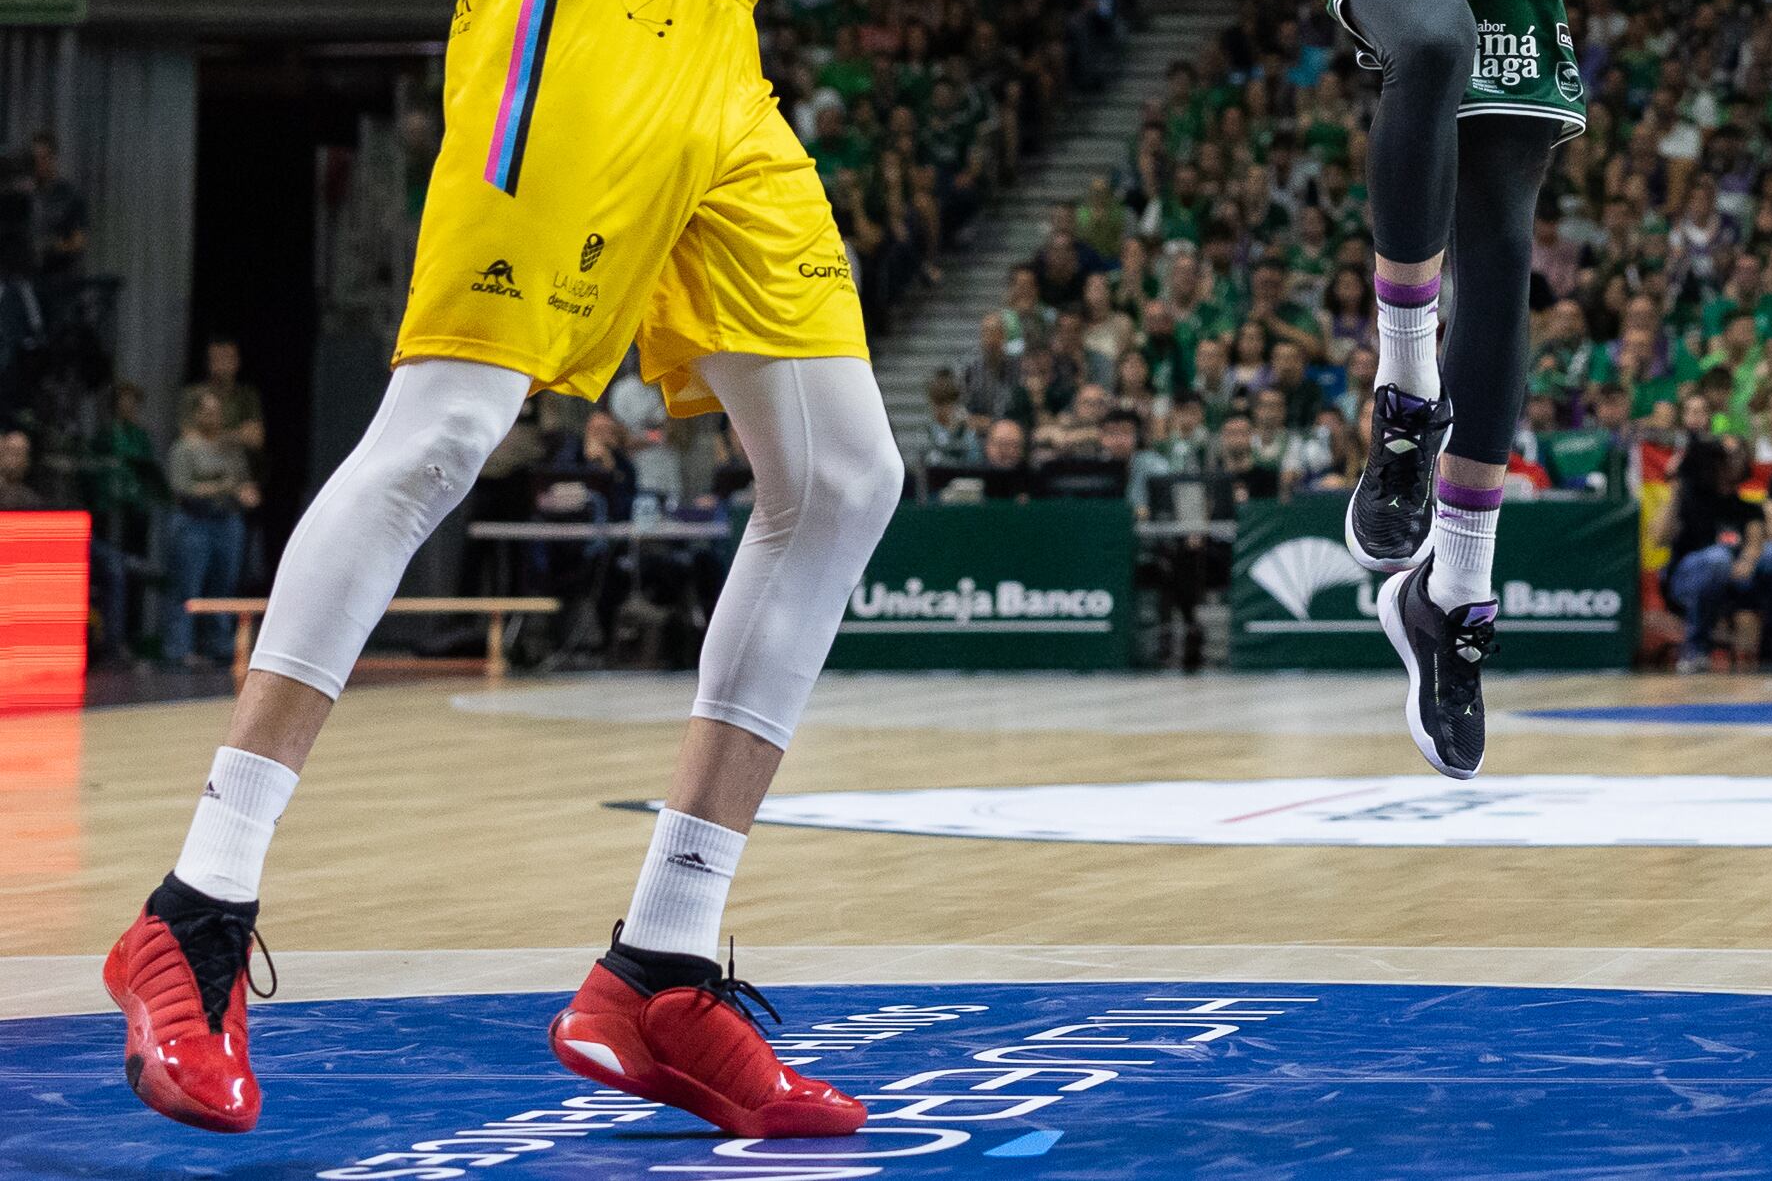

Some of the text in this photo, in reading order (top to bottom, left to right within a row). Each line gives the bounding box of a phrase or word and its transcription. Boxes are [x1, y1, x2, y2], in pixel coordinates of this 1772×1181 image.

[1477, 19, 1507, 33] abor
[852, 576, 1114, 626] Unicaja Banco
[1502, 579, 1622, 618] Banco
